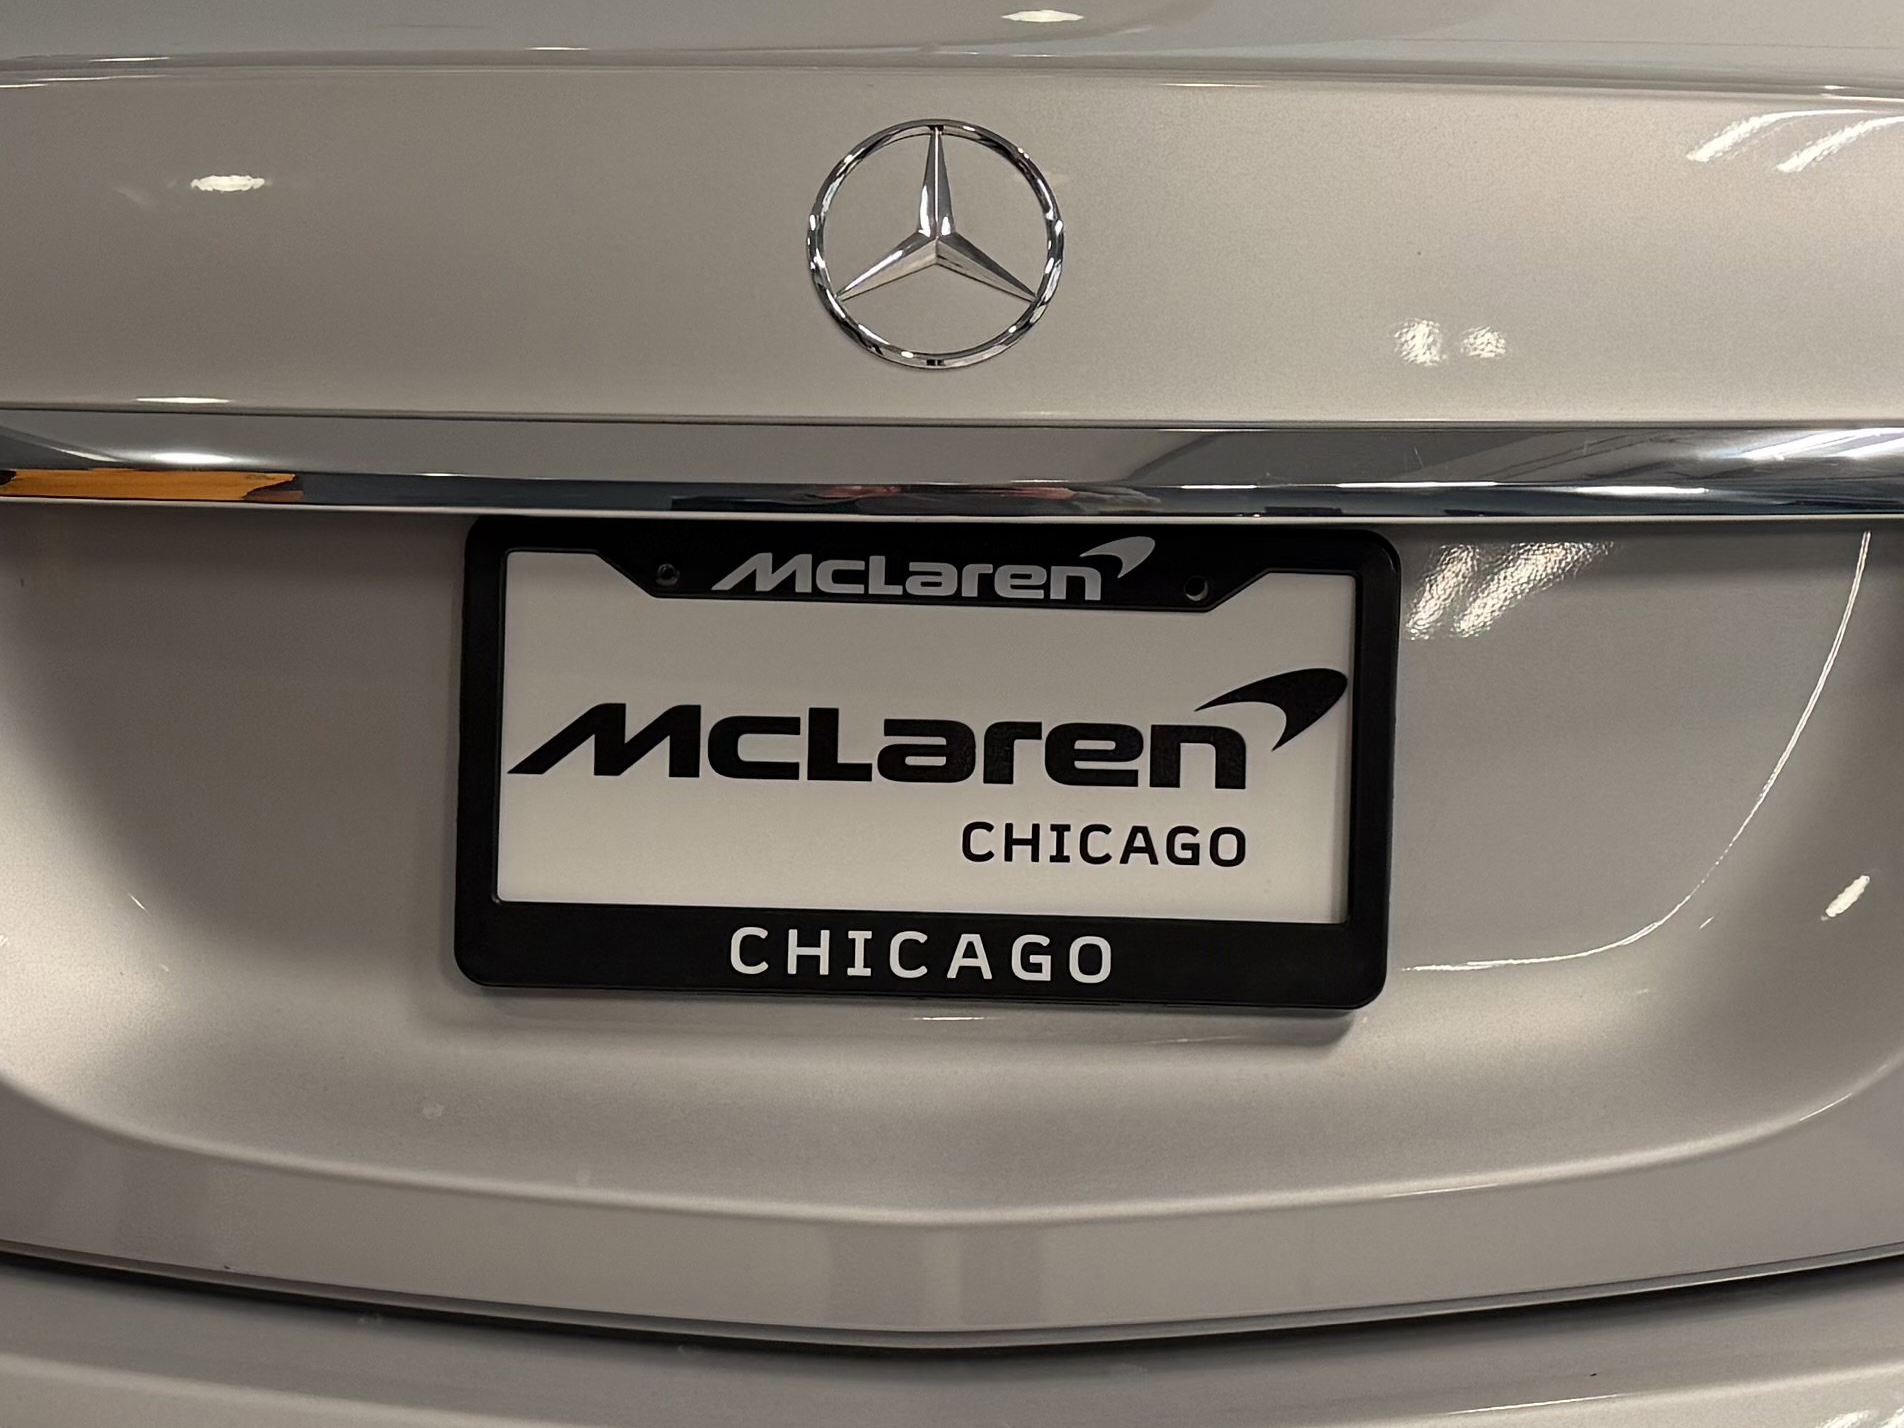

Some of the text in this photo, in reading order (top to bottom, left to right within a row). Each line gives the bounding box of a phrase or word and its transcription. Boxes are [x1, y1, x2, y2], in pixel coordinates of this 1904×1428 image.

[710, 553, 1102, 601] McLaren
[507, 702, 1247, 790] McLaren
[960, 820, 1248, 868] CHICAGO
[728, 925, 1113, 984] CHICAGO
